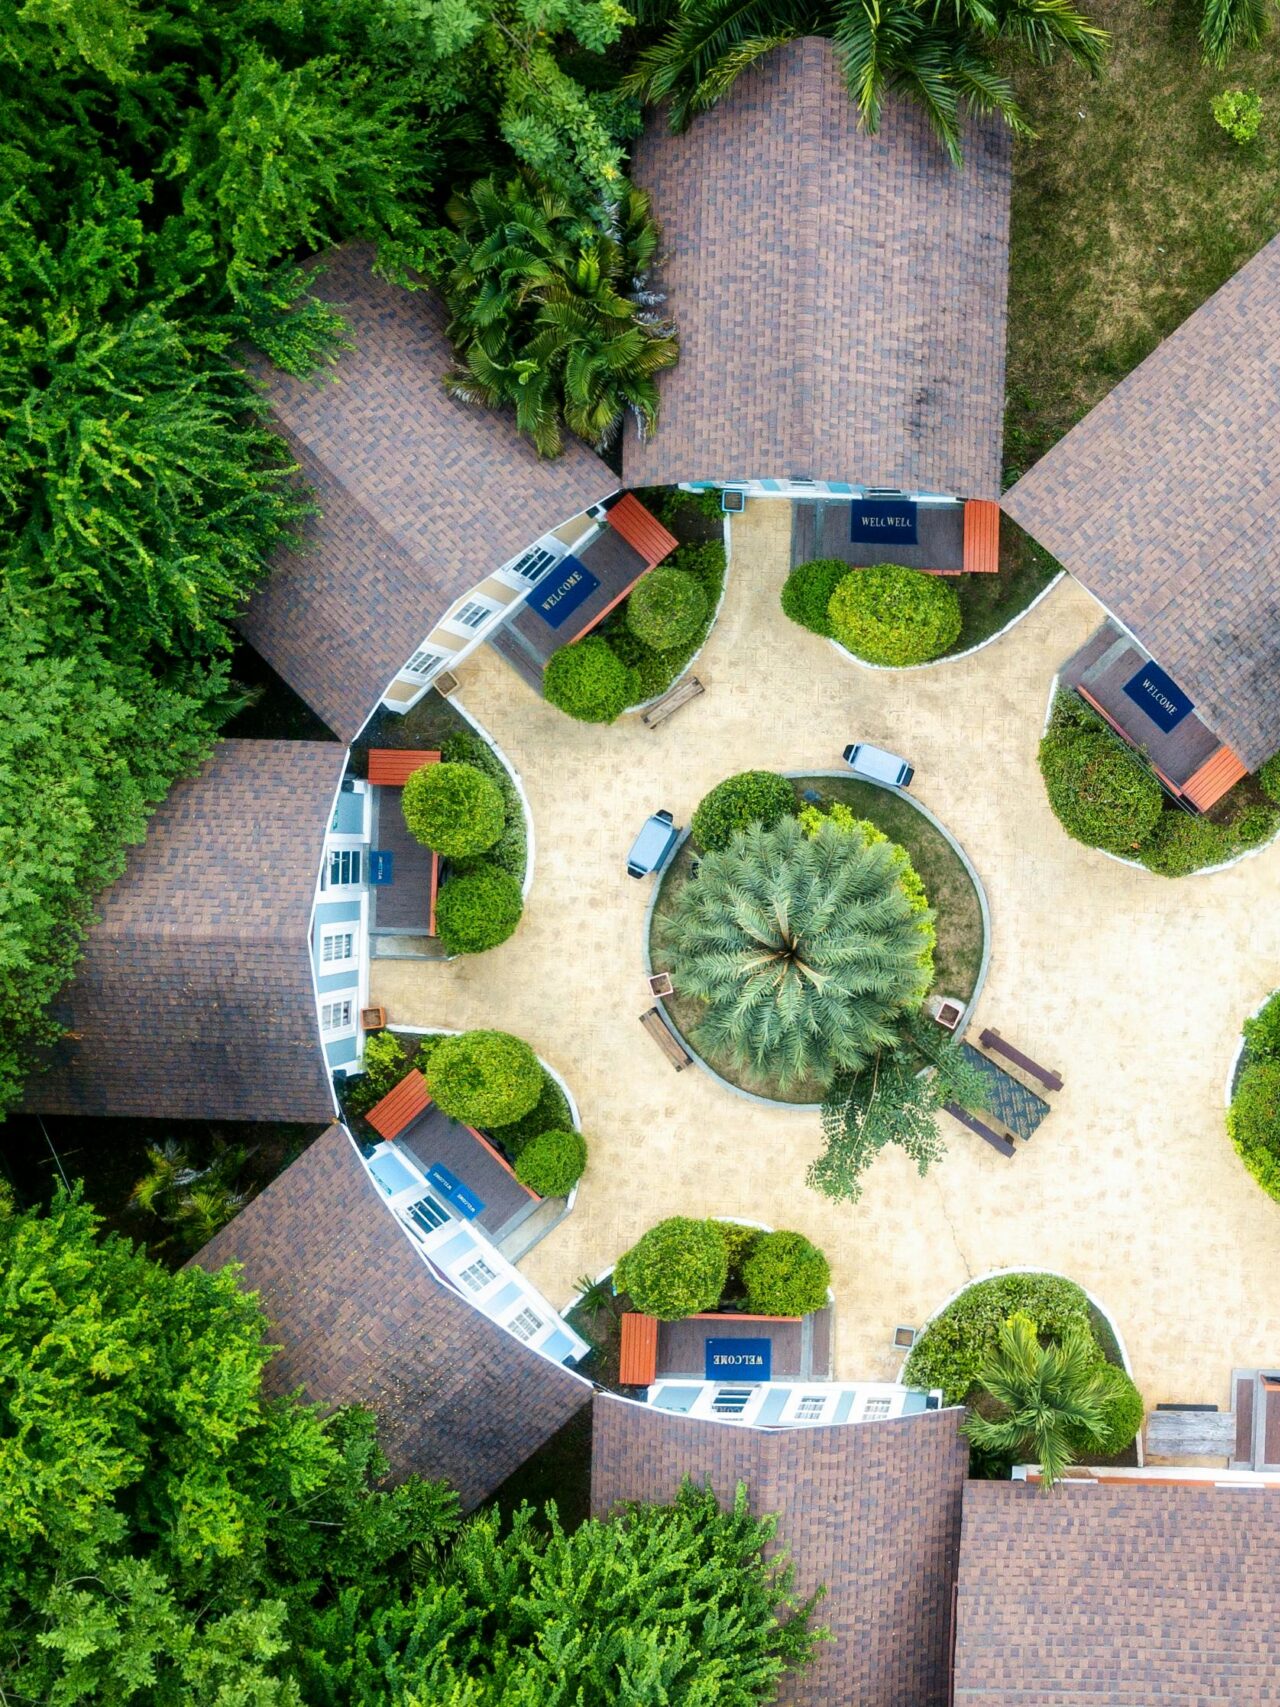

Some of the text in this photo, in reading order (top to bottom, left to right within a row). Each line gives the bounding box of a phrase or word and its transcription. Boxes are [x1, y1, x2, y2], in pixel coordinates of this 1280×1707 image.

[541, 570, 583, 612] WELCOME
[1141, 678, 1178, 716] WELCOME
[713, 1354, 764, 1365] WELCOME
